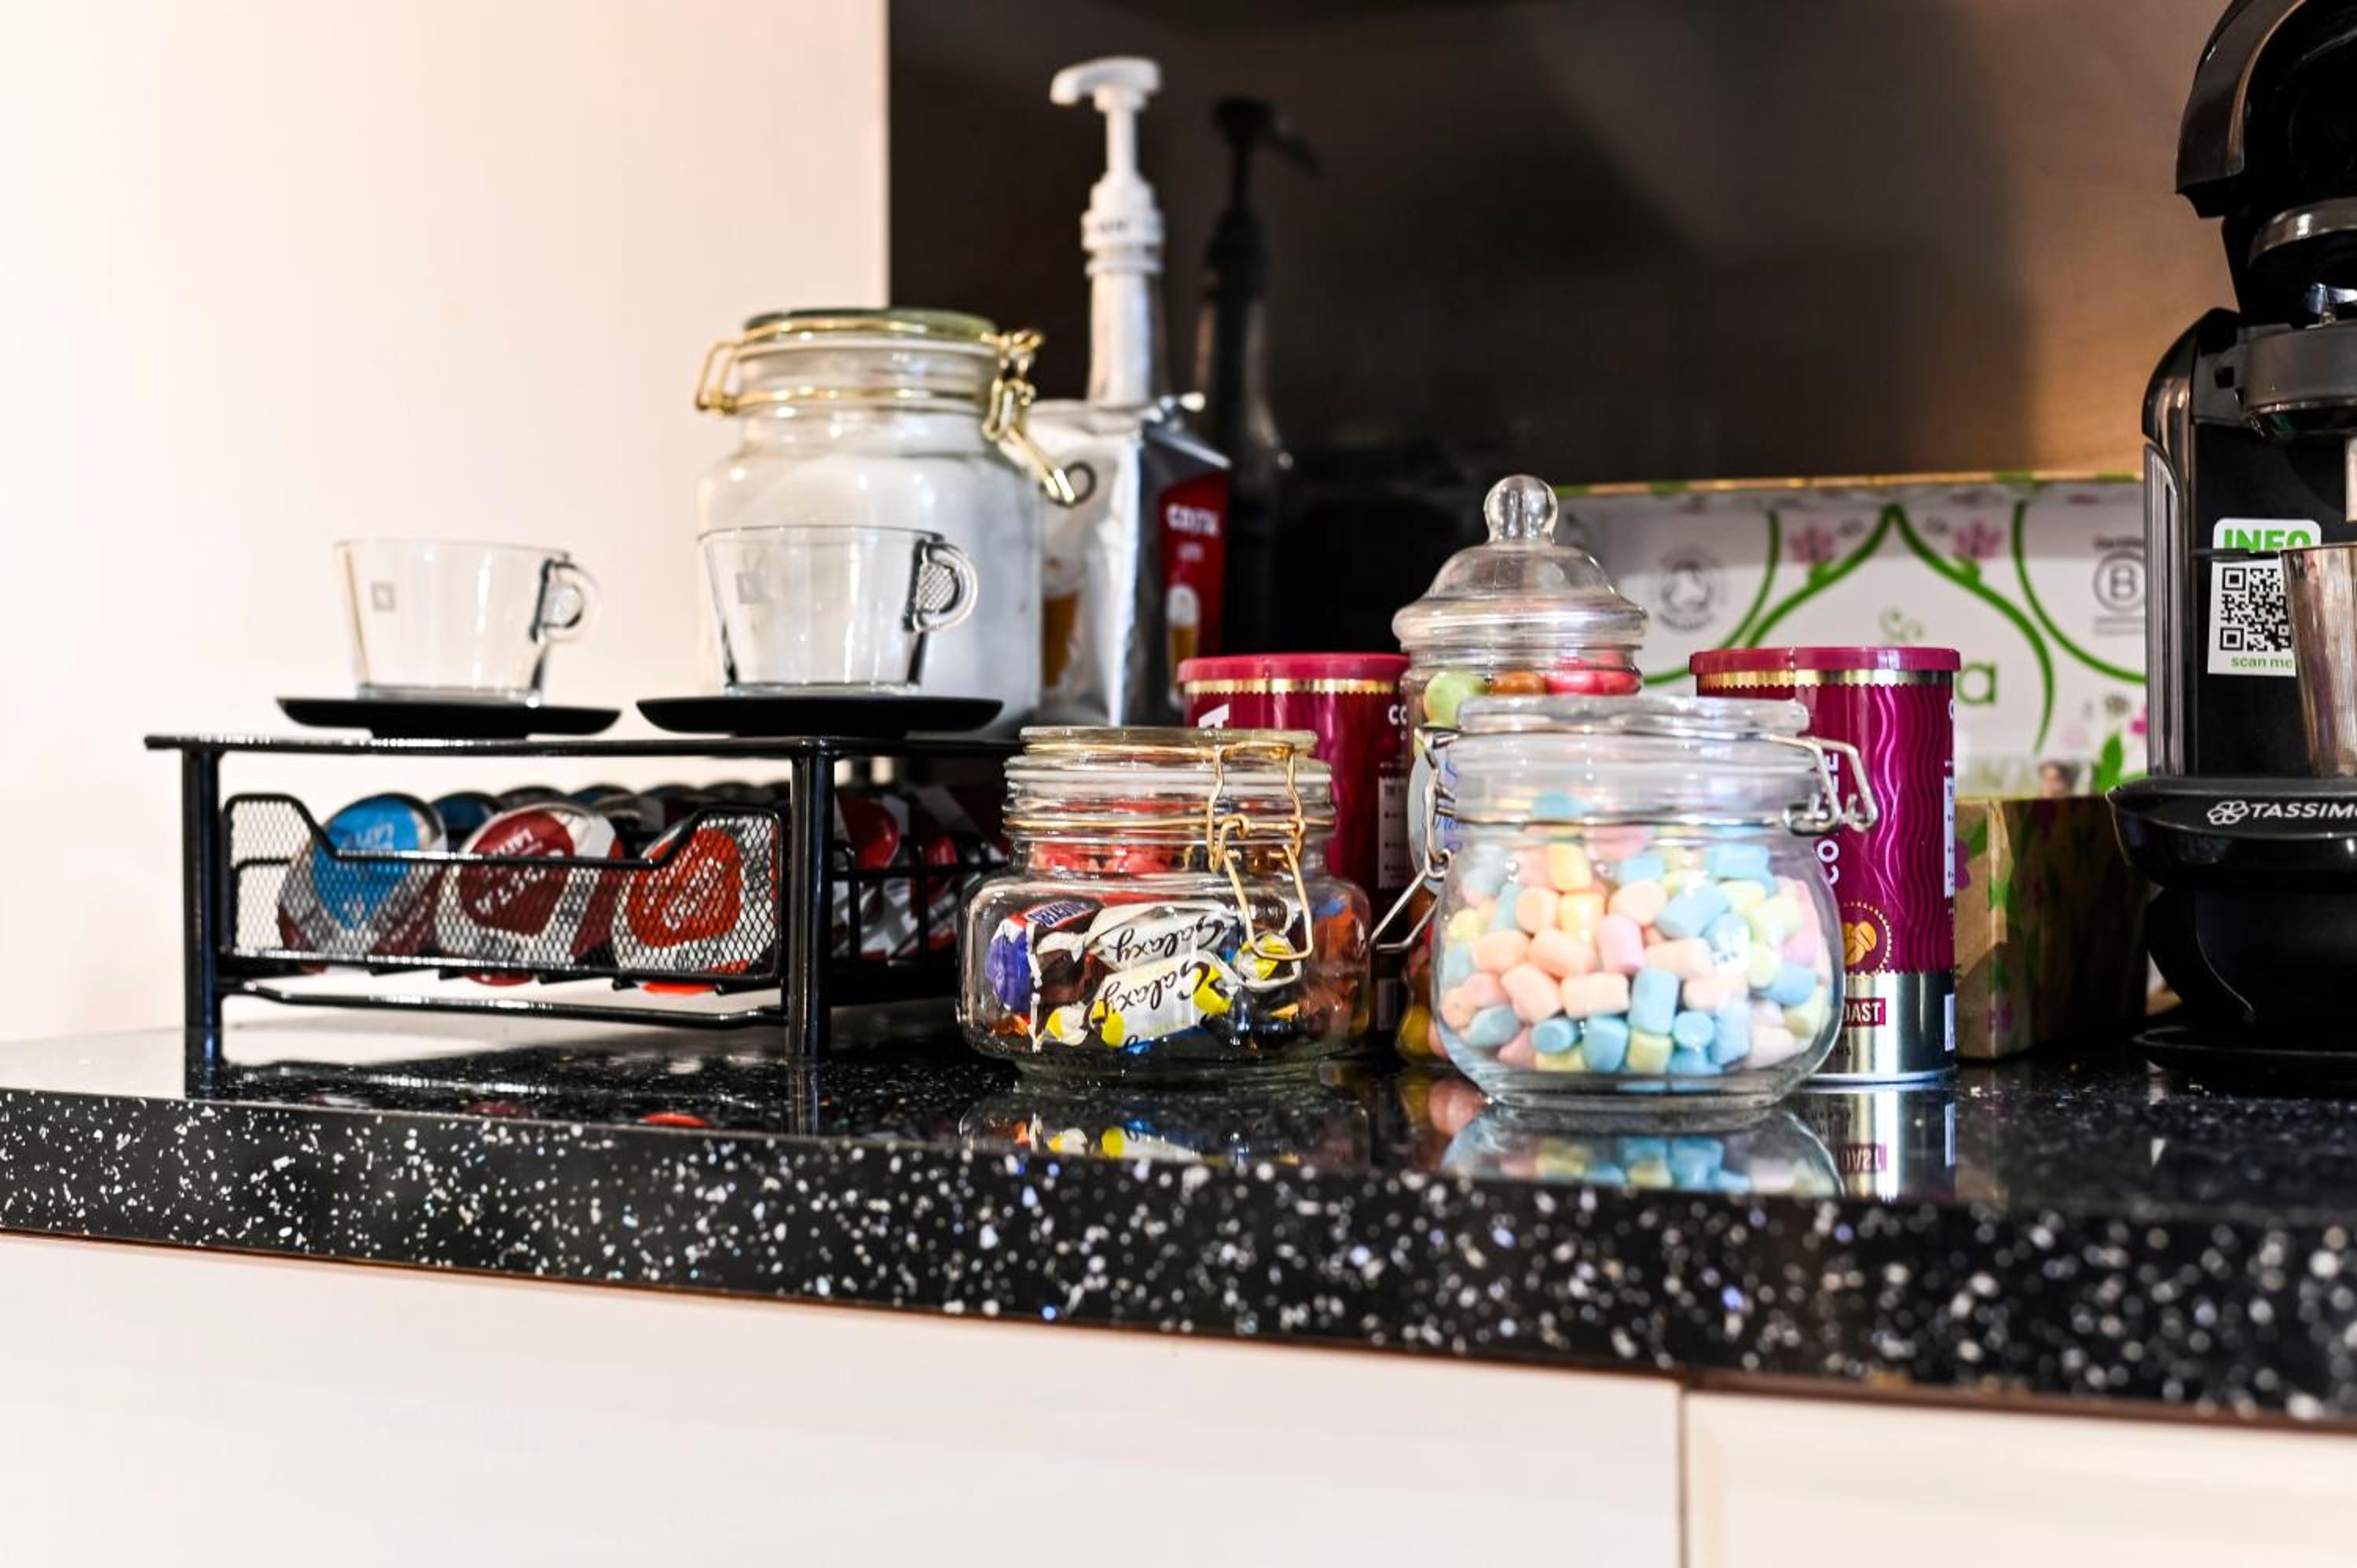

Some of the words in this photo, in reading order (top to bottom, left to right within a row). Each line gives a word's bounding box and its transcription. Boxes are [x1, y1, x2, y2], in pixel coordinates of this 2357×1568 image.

[2231, 657, 2267, 668] scan
[2250, 803, 2357, 819] TASSIM
[1109, 915, 1227, 963] Galaxy
[1103, 958, 1211, 1019] Galaxy
